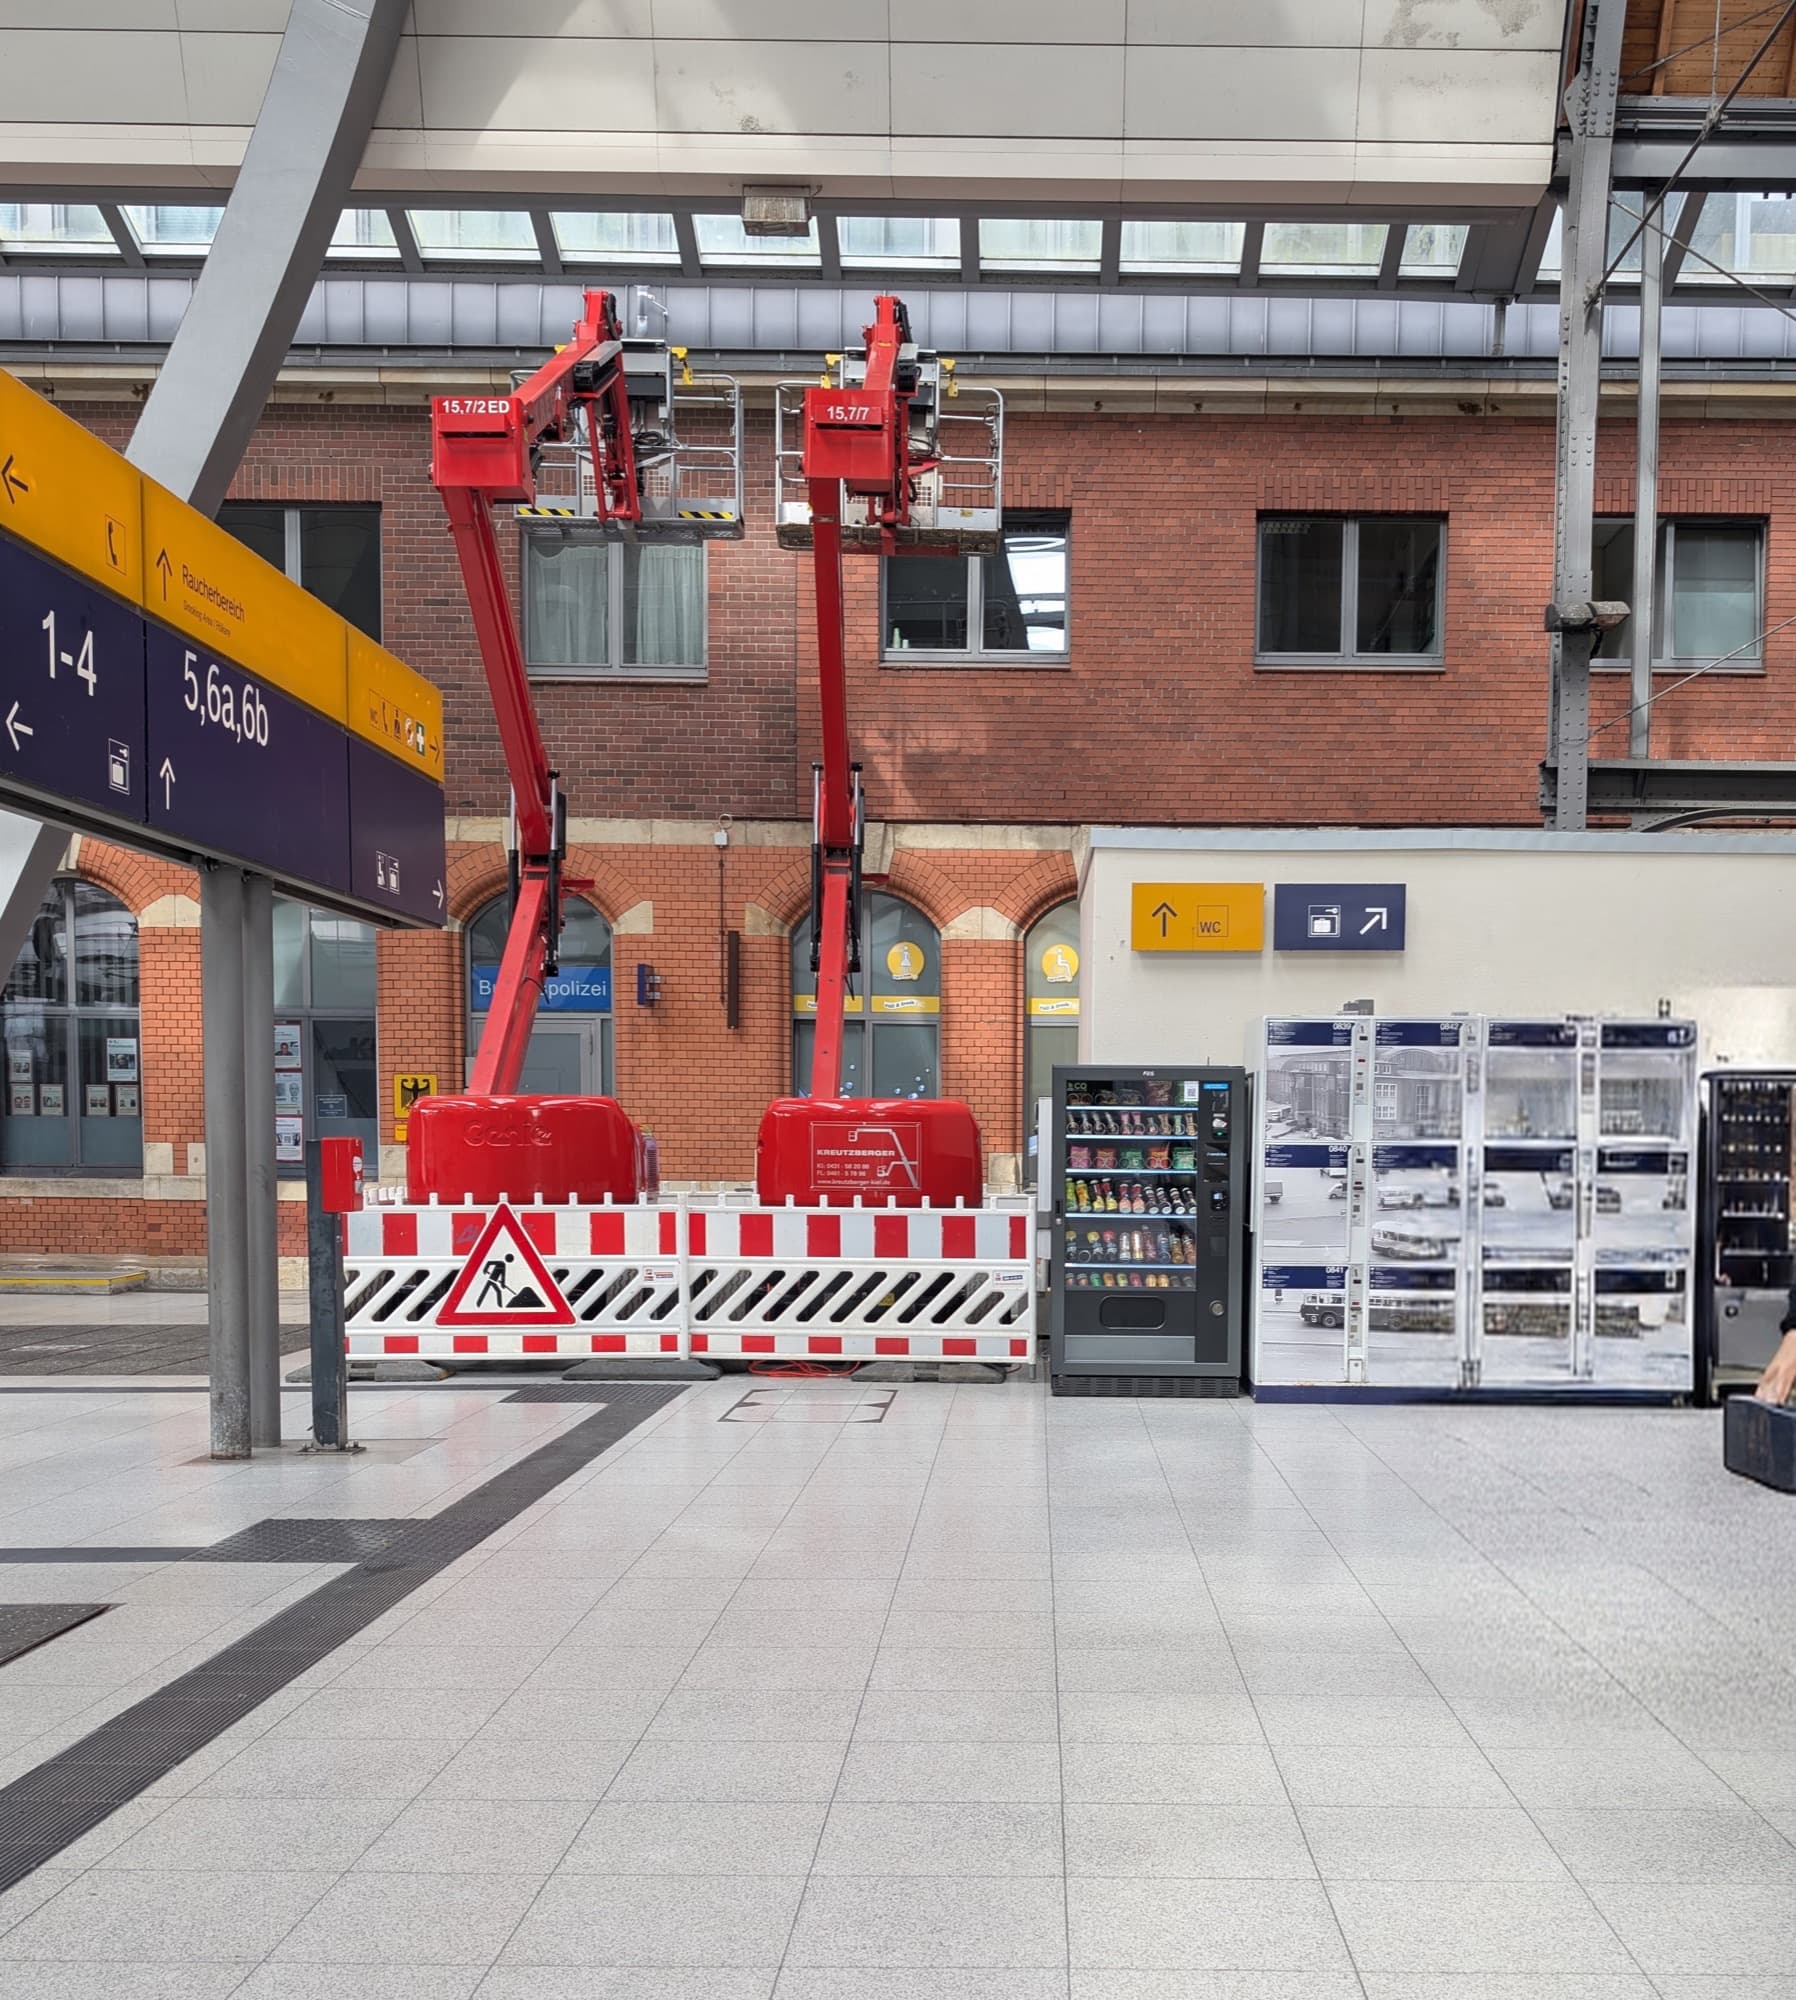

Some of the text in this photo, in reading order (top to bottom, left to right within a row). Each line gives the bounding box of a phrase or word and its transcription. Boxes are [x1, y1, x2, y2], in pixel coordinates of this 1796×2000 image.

[827, 406, 870, 422] 15,7/7
[182, 563, 245, 623] Raucherbereich
[42, 609, 97, 697] 1-4
[184, 649, 269, 747] 5,6a,6b
[1200, 921, 1222, 934] WC
[816, 1149, 896, 1157] KREUTZBERGER
